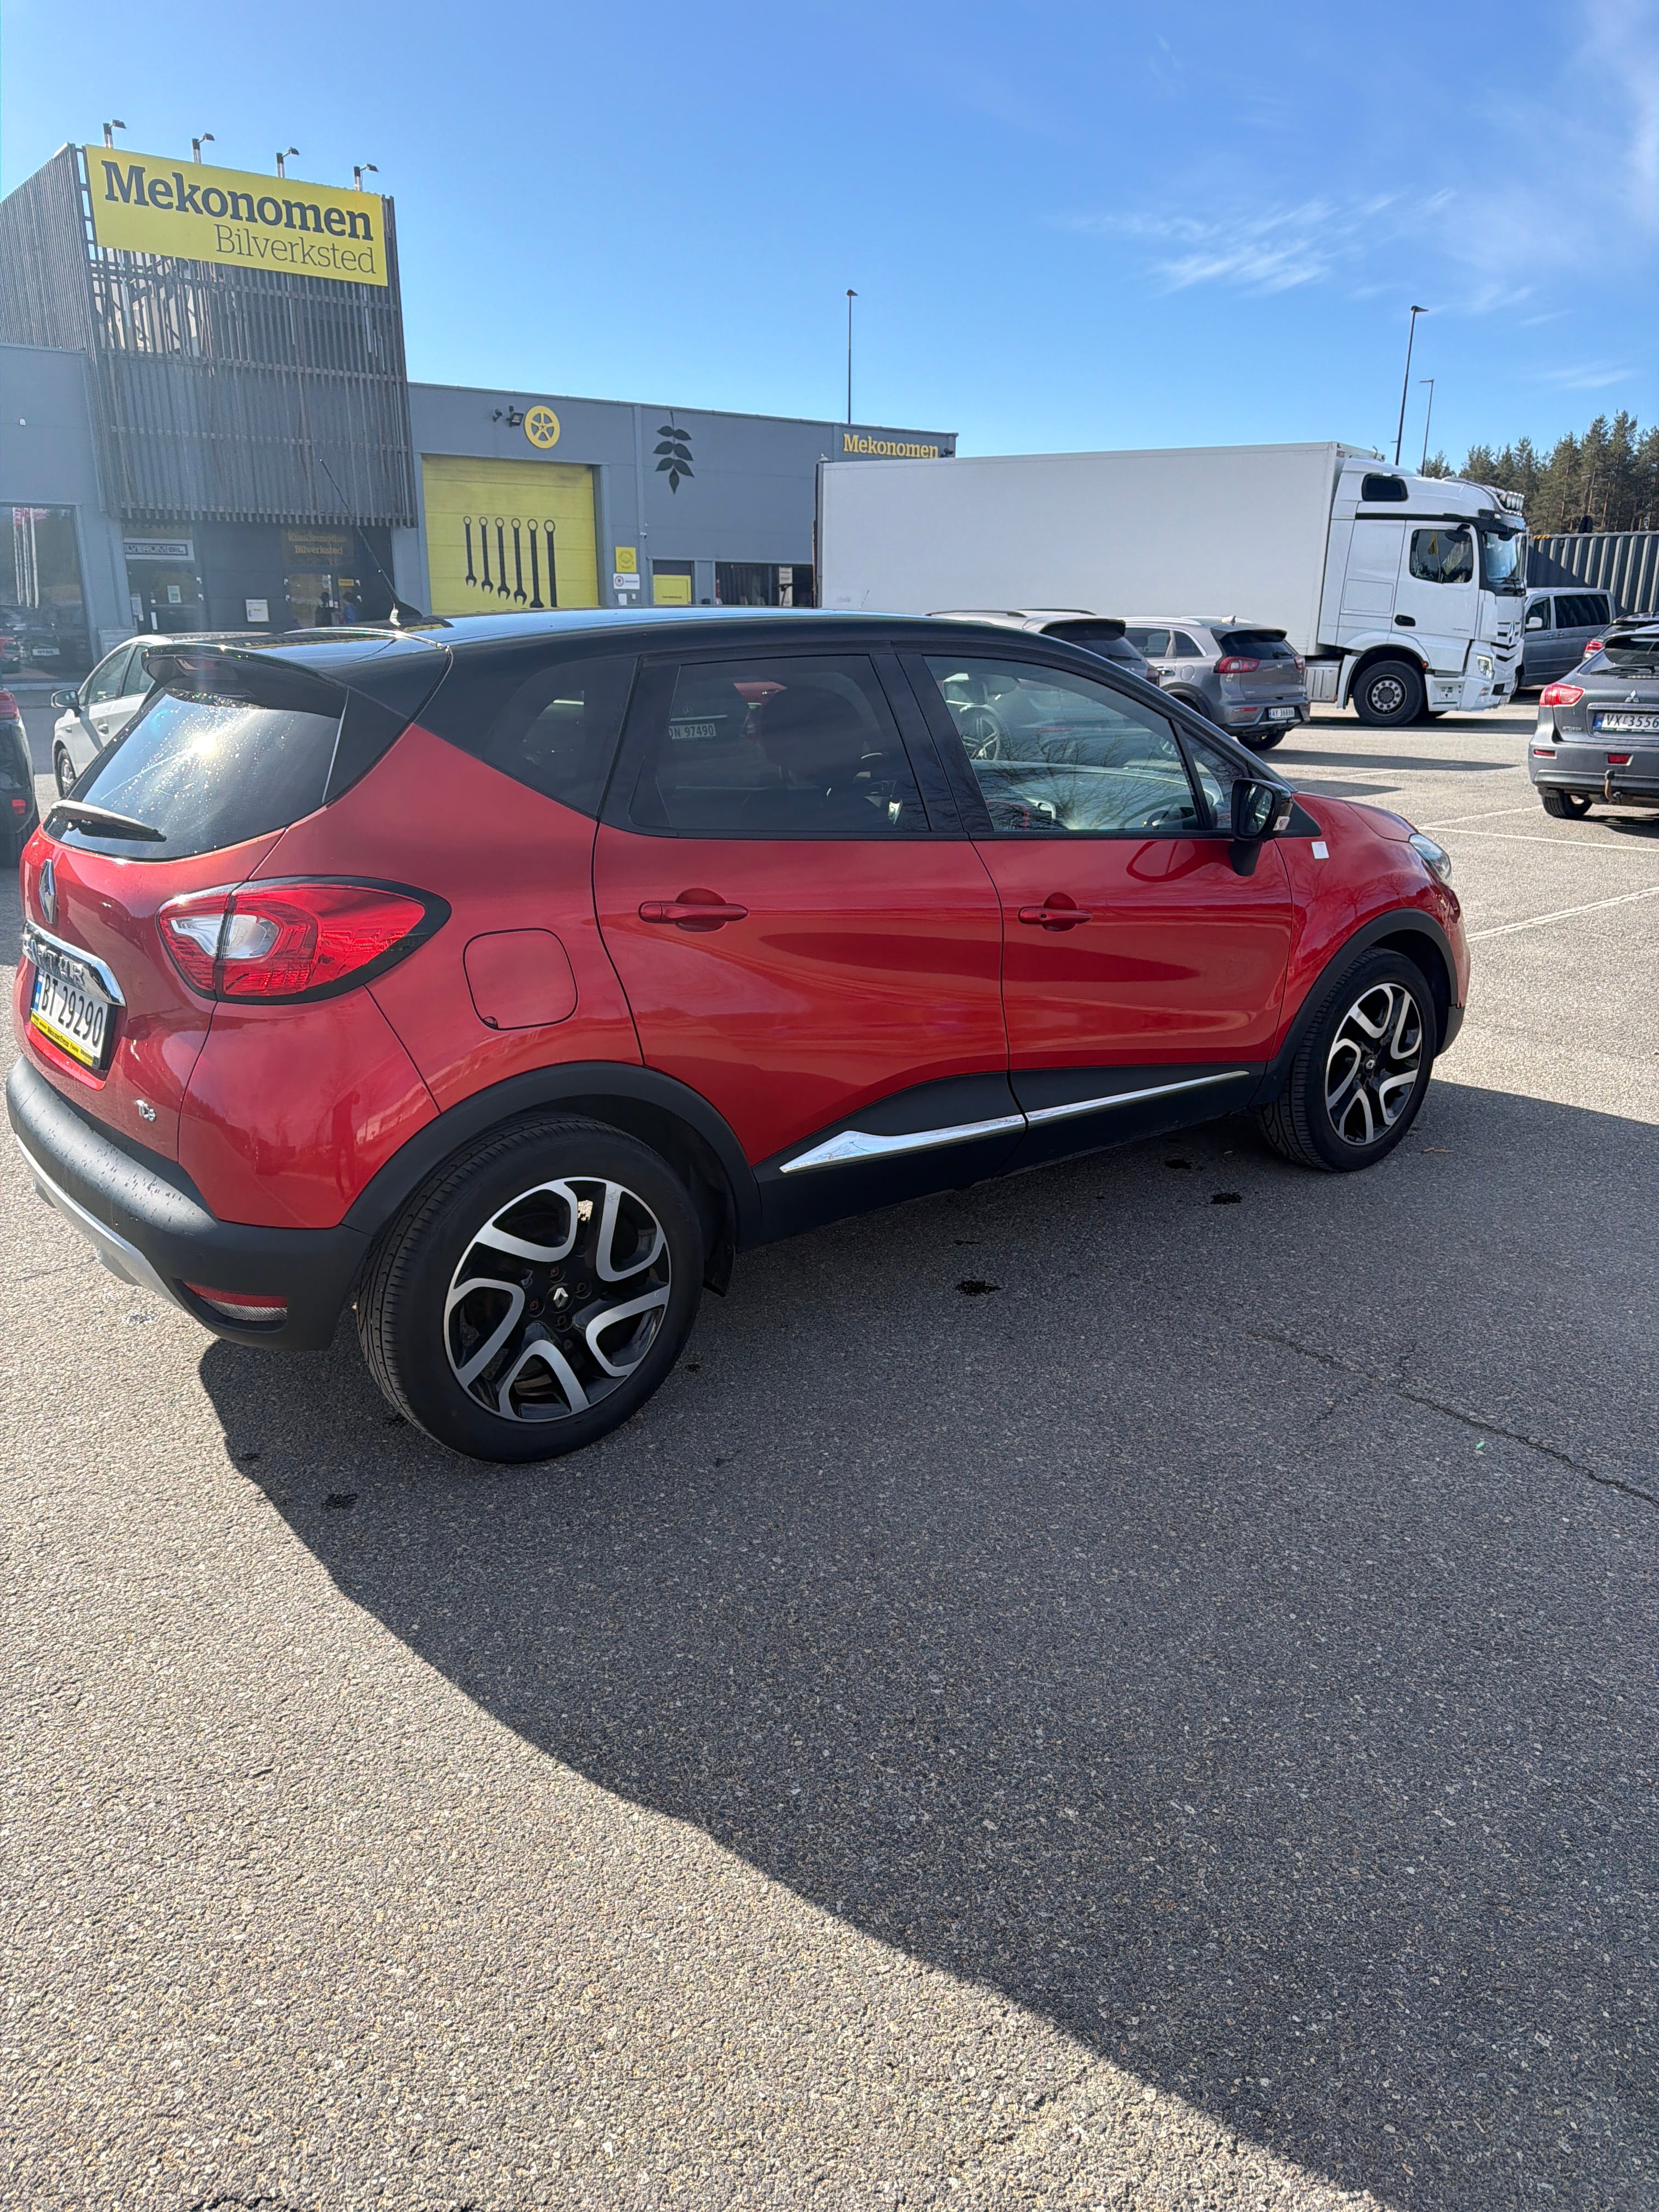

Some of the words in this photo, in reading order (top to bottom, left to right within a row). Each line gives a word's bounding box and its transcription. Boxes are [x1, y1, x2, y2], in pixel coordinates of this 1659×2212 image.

[101, 160, 374, 241] Mekonomen
[214, 223, 377, 274] Bilverksted
[843, 433, 939, 459] Mekonomen
[295, 545, 343, 555] Bilverksted
[684, 725, 714, 737] 97490
[1607, 714, 1622, 726] VX
[41, 973, 58, 1017] BT
[58, 985, 103, 1048] 29290
